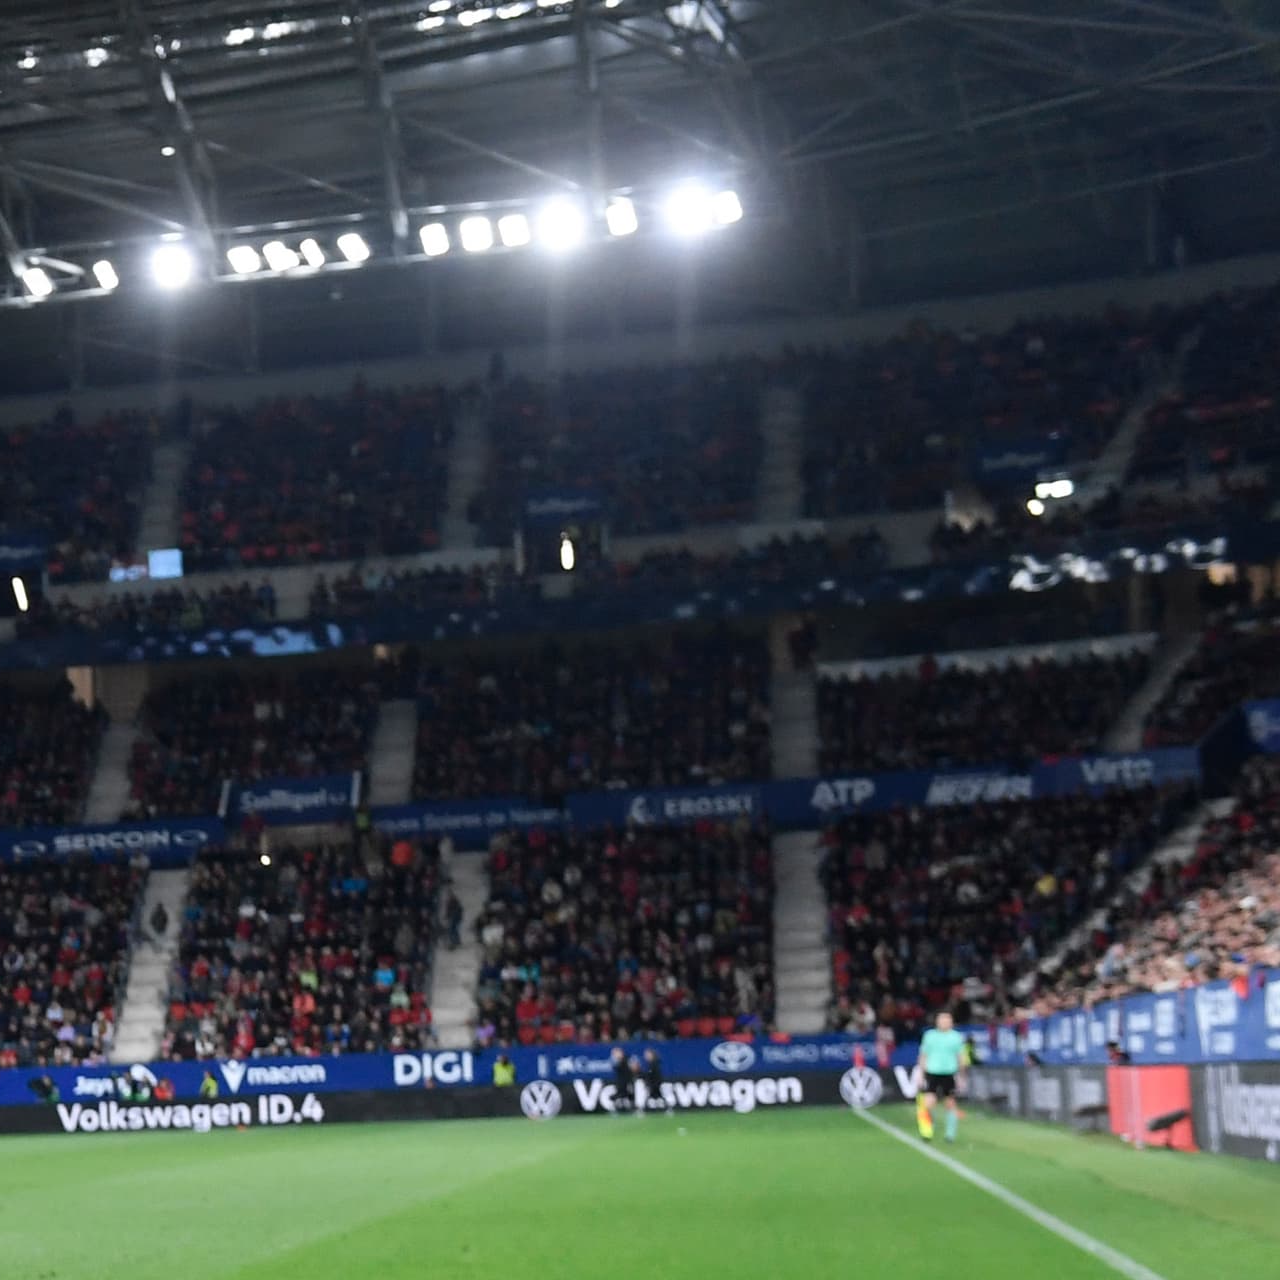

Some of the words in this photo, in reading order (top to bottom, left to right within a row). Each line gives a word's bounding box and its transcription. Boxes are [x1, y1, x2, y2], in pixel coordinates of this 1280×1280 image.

[664, 797, 752, 816] EROSKI
[247, 1062, 327, 1086] macron
[393, 1051, 474, 1086] DIGI
[57, 1101, 252, 1133] Volkswagen
[258, 1093, 325, 1125] ID.4
